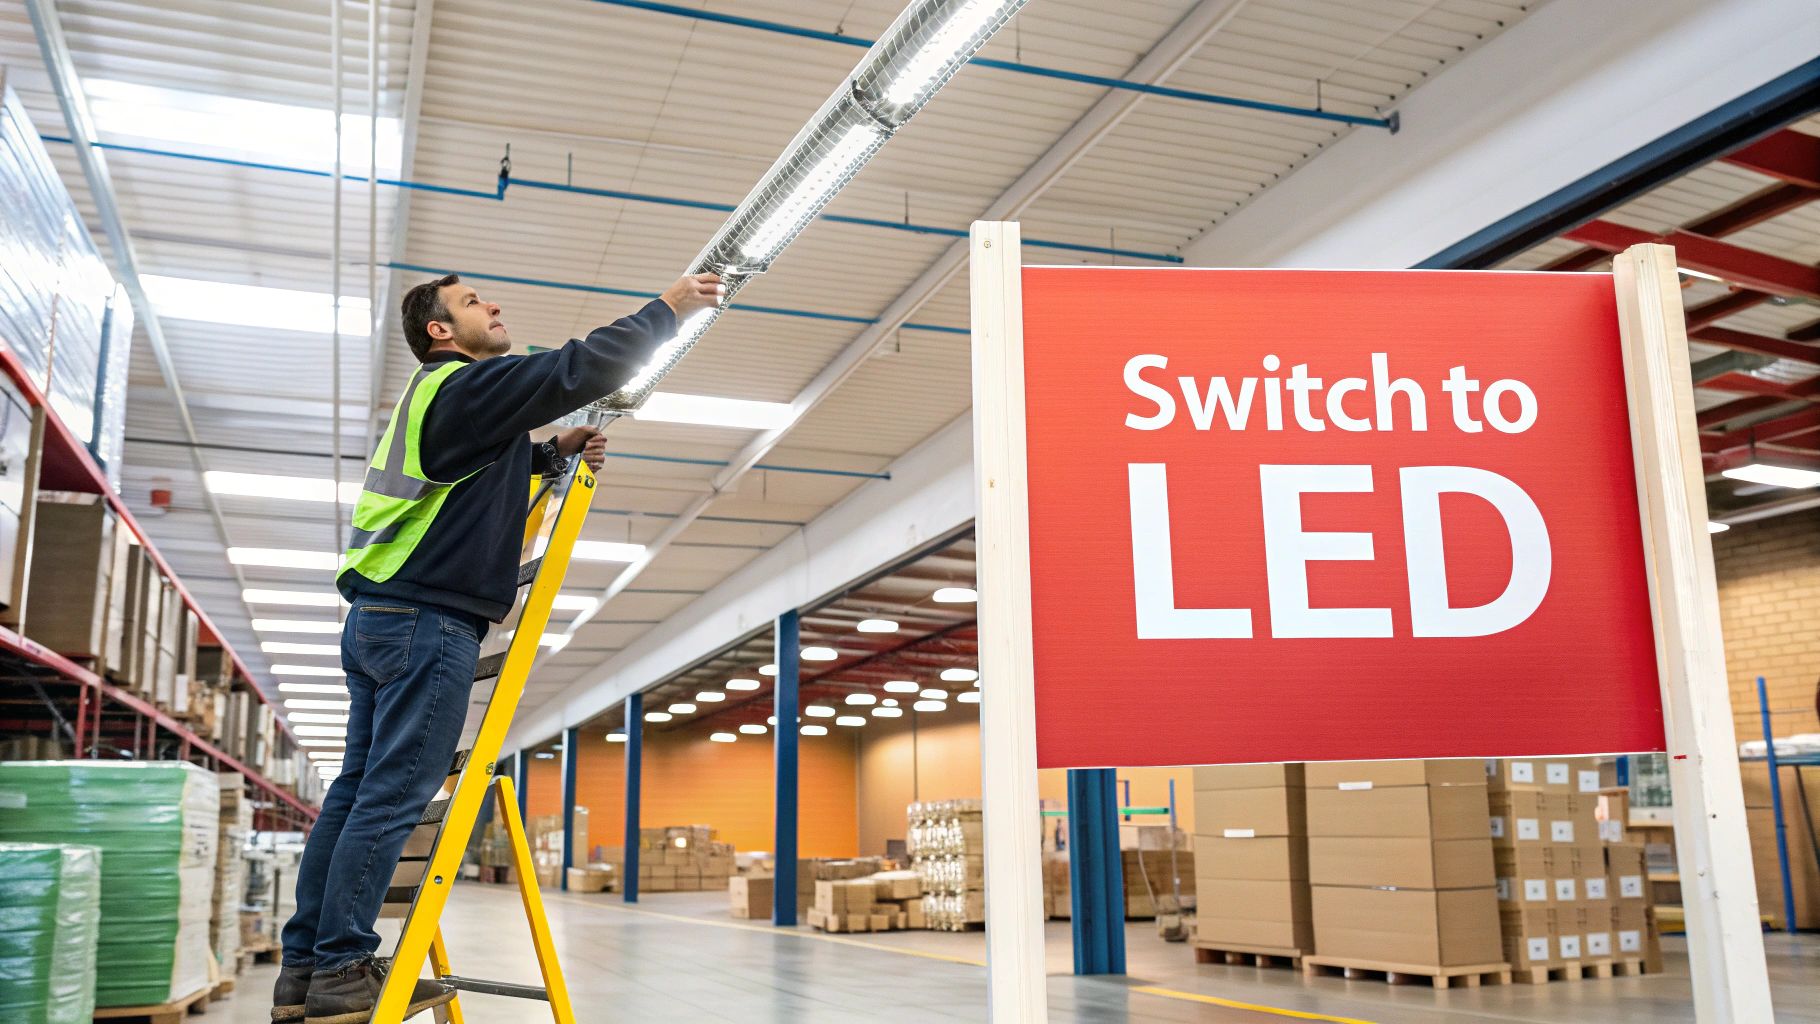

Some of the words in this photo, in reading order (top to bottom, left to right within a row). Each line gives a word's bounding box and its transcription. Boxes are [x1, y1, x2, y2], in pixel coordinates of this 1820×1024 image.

[1123, 352, 1428, 432] Switch
[1441, 365, 1538, 434] to
[1127, 462, 1552, 640] LED
